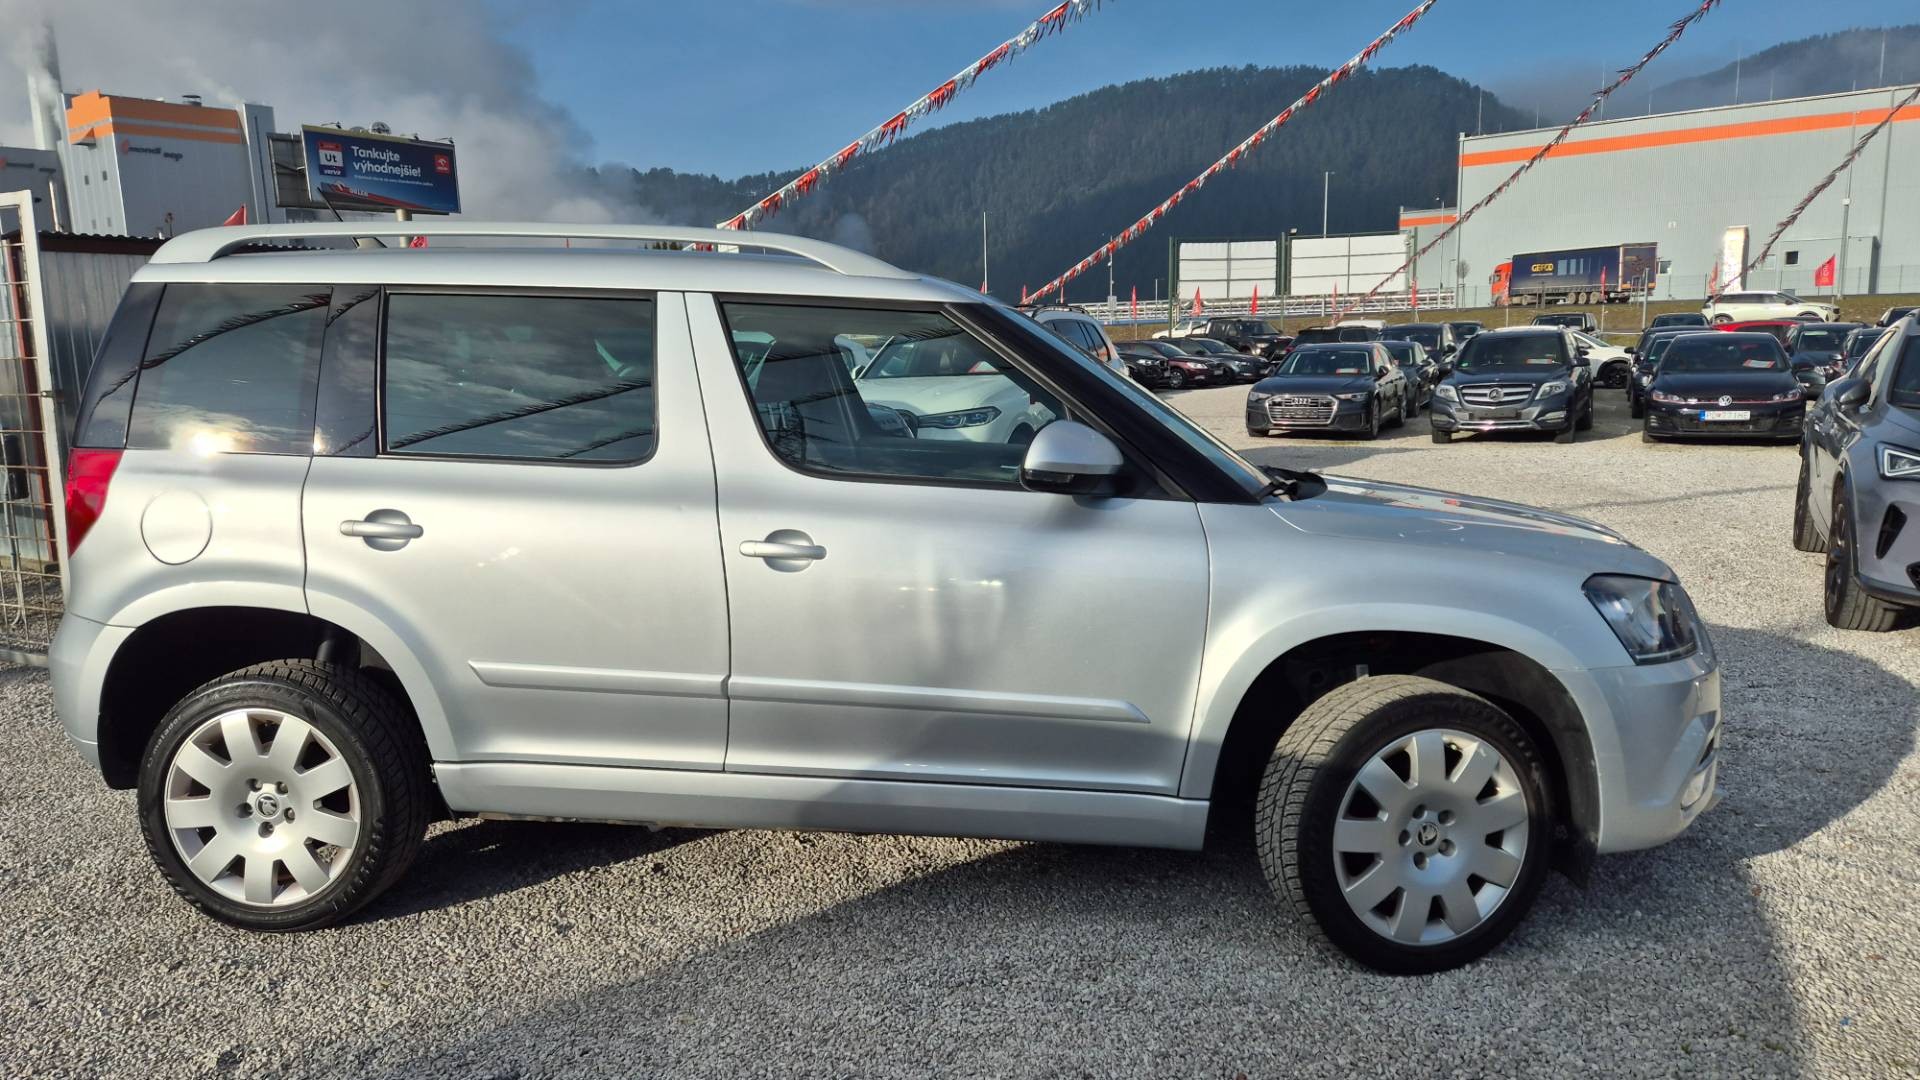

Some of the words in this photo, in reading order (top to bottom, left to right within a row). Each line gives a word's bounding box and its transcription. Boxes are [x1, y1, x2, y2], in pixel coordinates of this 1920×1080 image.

[324, 153, 337, 163] Ut
[351, 145, 400, 163] Tankujte
[353, 160, 421, 177] výhodnejšie!
